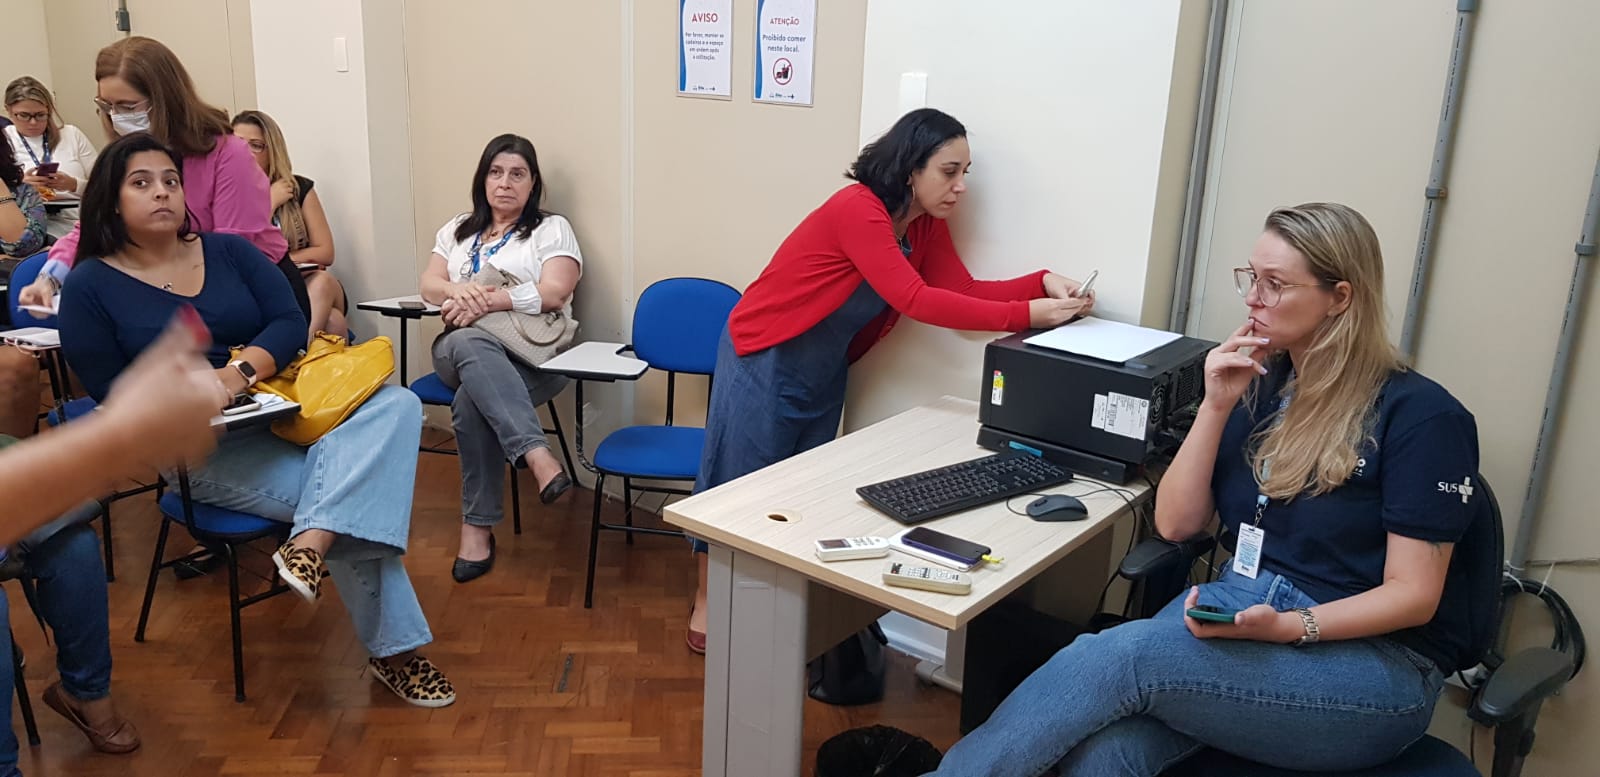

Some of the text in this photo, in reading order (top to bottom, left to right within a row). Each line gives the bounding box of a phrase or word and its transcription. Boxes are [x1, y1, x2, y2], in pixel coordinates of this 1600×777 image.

[692, 12, 718, 22] AVISO
[770, 16, 800, 26] ATENÇÃO
[762, 34, 786, 42] Proibido
[1437, 482, 1458, 493] SUS
